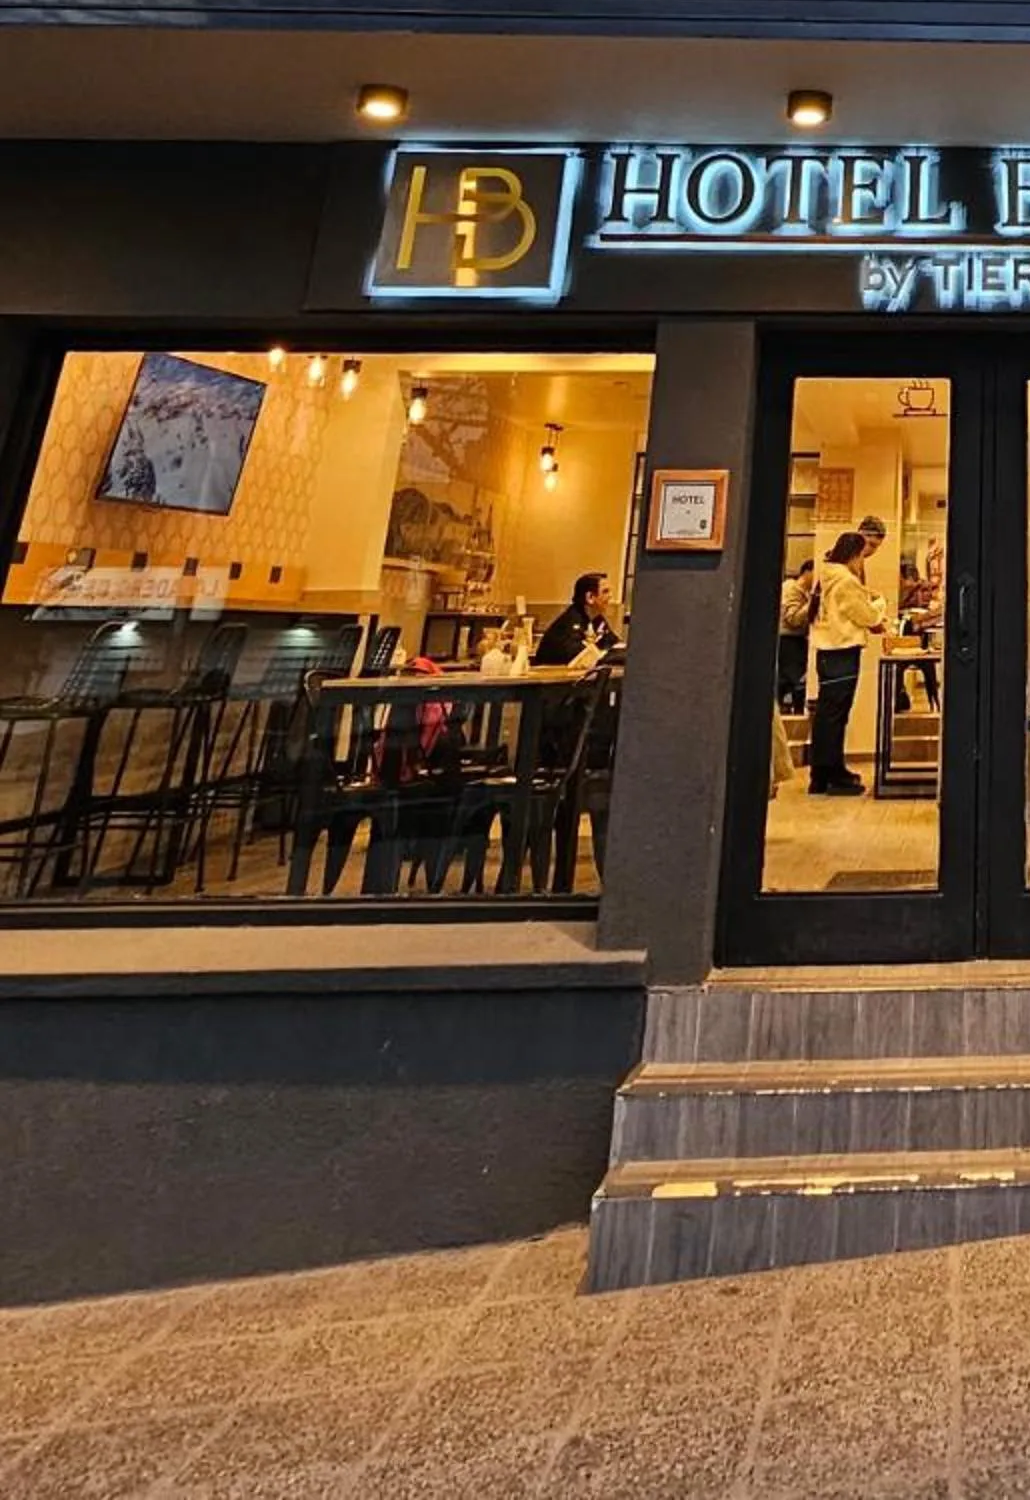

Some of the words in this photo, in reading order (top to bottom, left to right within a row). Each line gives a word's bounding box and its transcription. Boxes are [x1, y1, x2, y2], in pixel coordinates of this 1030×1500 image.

[604, 152, 951, 224] HOTEL
[863, 255, 915, 299] by
[671, 495, 705, 505] HOTEL
